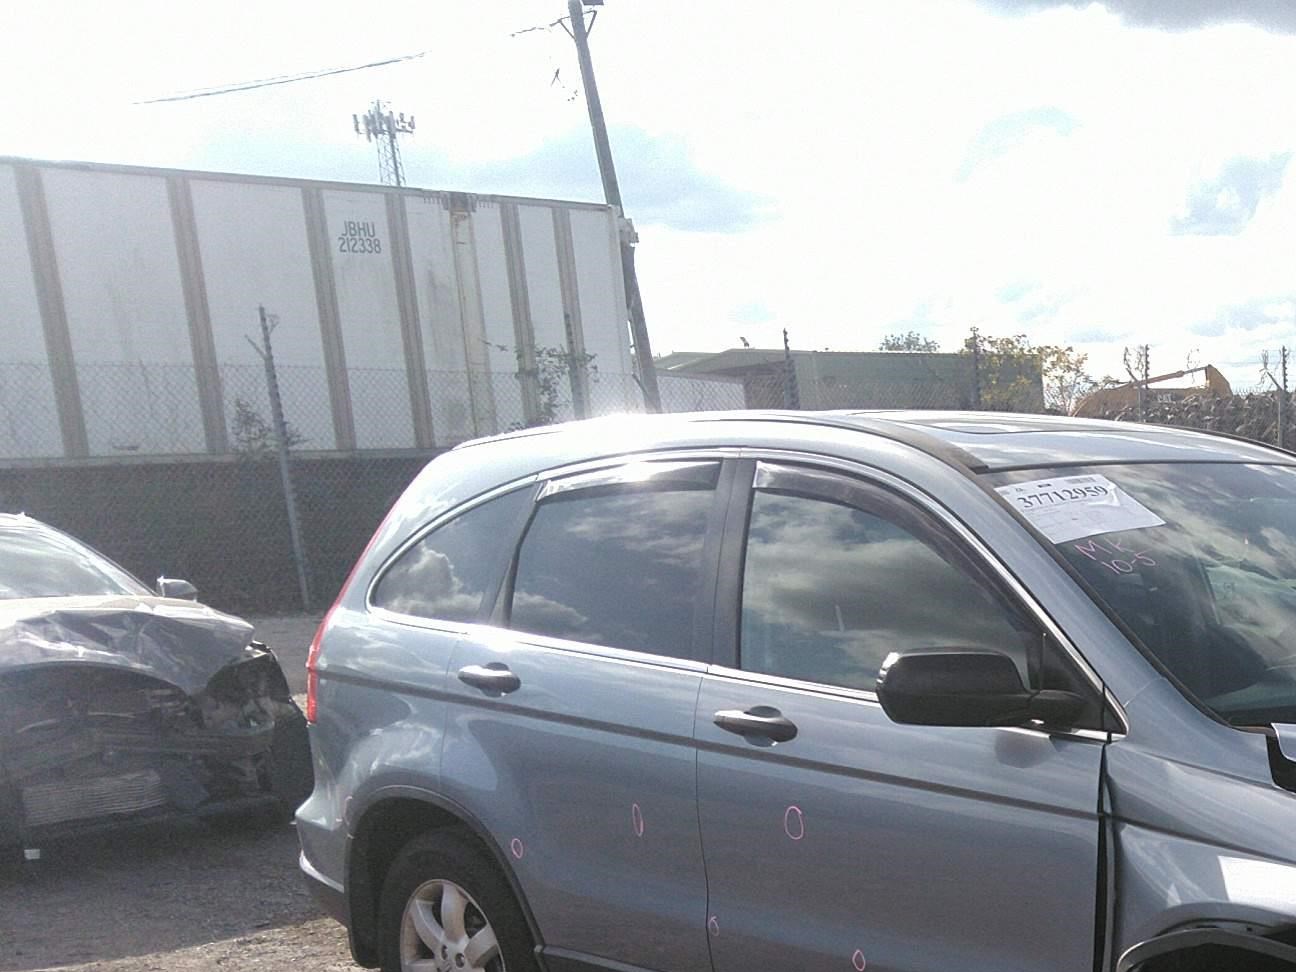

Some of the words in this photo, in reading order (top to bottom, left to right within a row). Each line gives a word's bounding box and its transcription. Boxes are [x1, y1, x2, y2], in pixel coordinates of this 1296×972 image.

[341, 220, 376, 238] JBHU
[338, 237, 382, 254] 212338
[1017, 485, 1108, 508] 37712959
